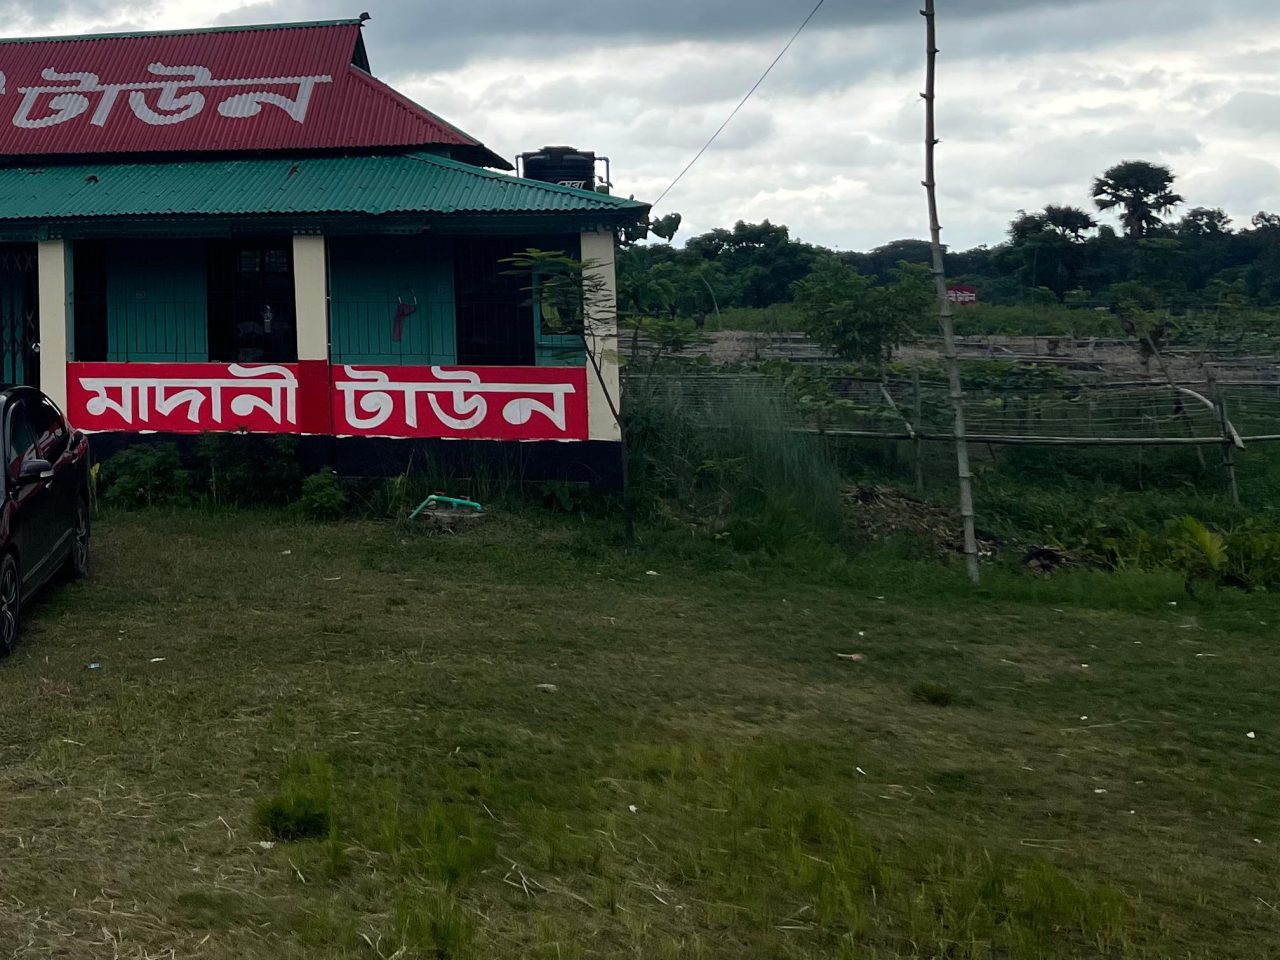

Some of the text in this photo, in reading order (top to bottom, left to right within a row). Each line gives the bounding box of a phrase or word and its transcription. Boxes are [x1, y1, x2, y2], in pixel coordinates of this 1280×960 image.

[11, 62, 333, 129] টাউন
[78, 363, 575, 432] মাদানী টাউন
